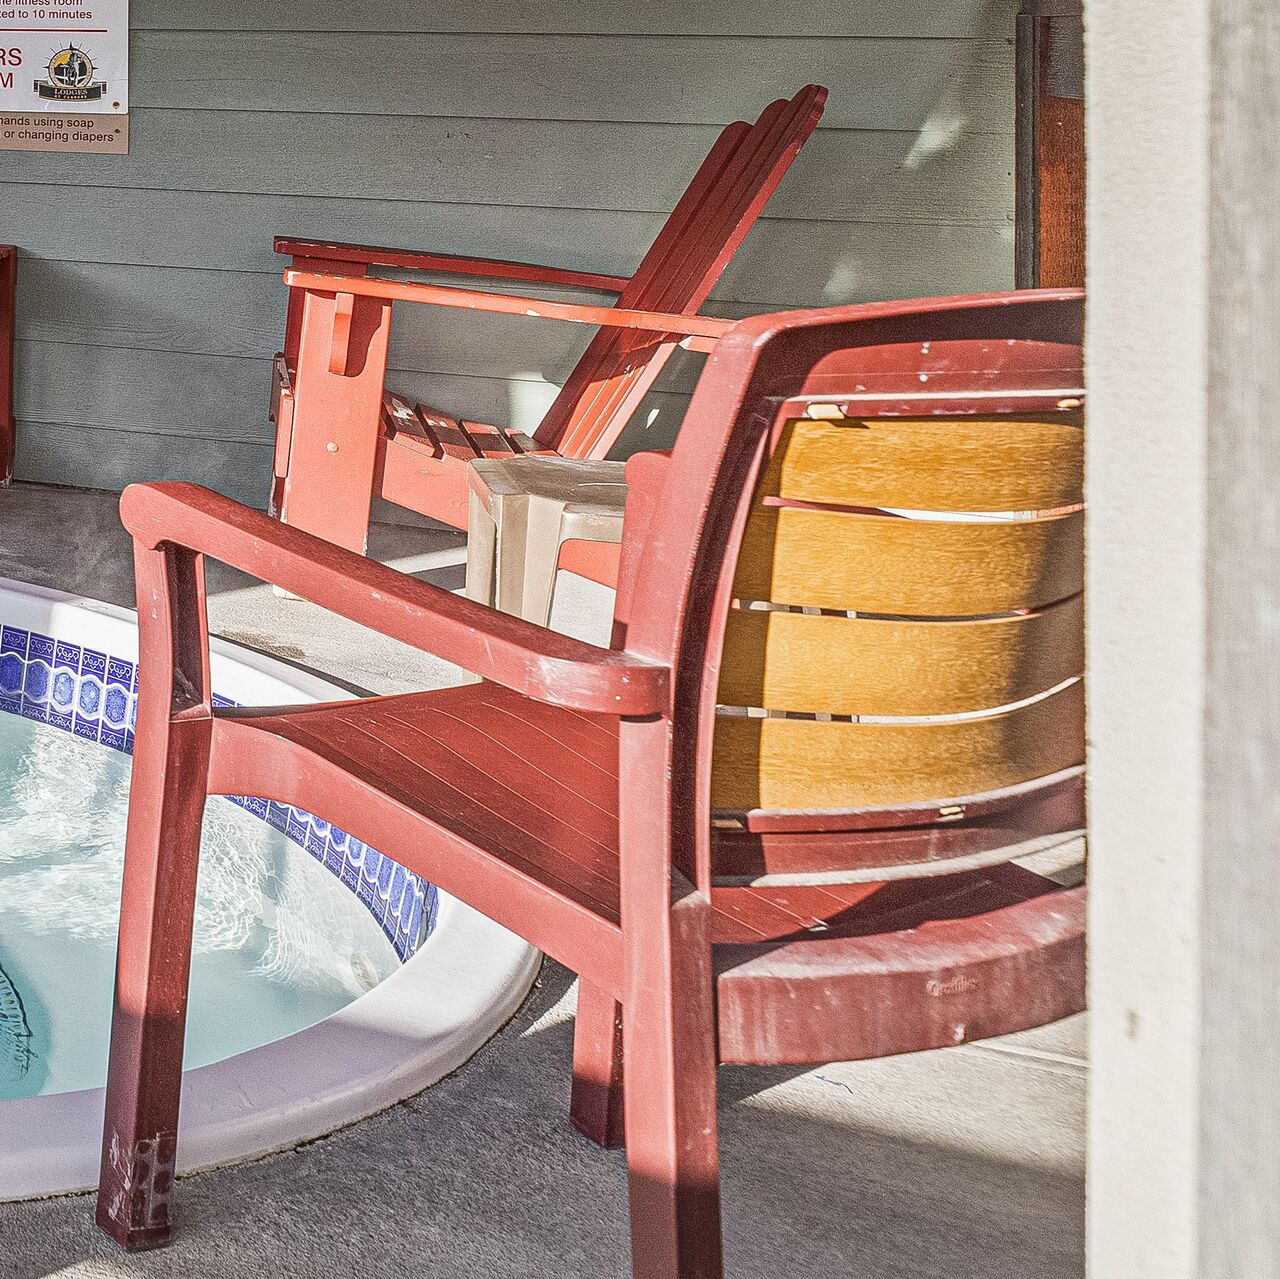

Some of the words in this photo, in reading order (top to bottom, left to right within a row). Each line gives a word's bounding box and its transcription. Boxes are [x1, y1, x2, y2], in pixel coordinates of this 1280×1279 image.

[18, 9, 29, 19] to
[32, 9, 45, 19] 10
[48, 9, 92, 19] minutes
[33, 116, 63, 129] using
[66, 119, 94, 130] soap
[3, 130, 15, 138] or
[18, 129, 68, 143] changing
[72, 131, 114, 143] diapers
